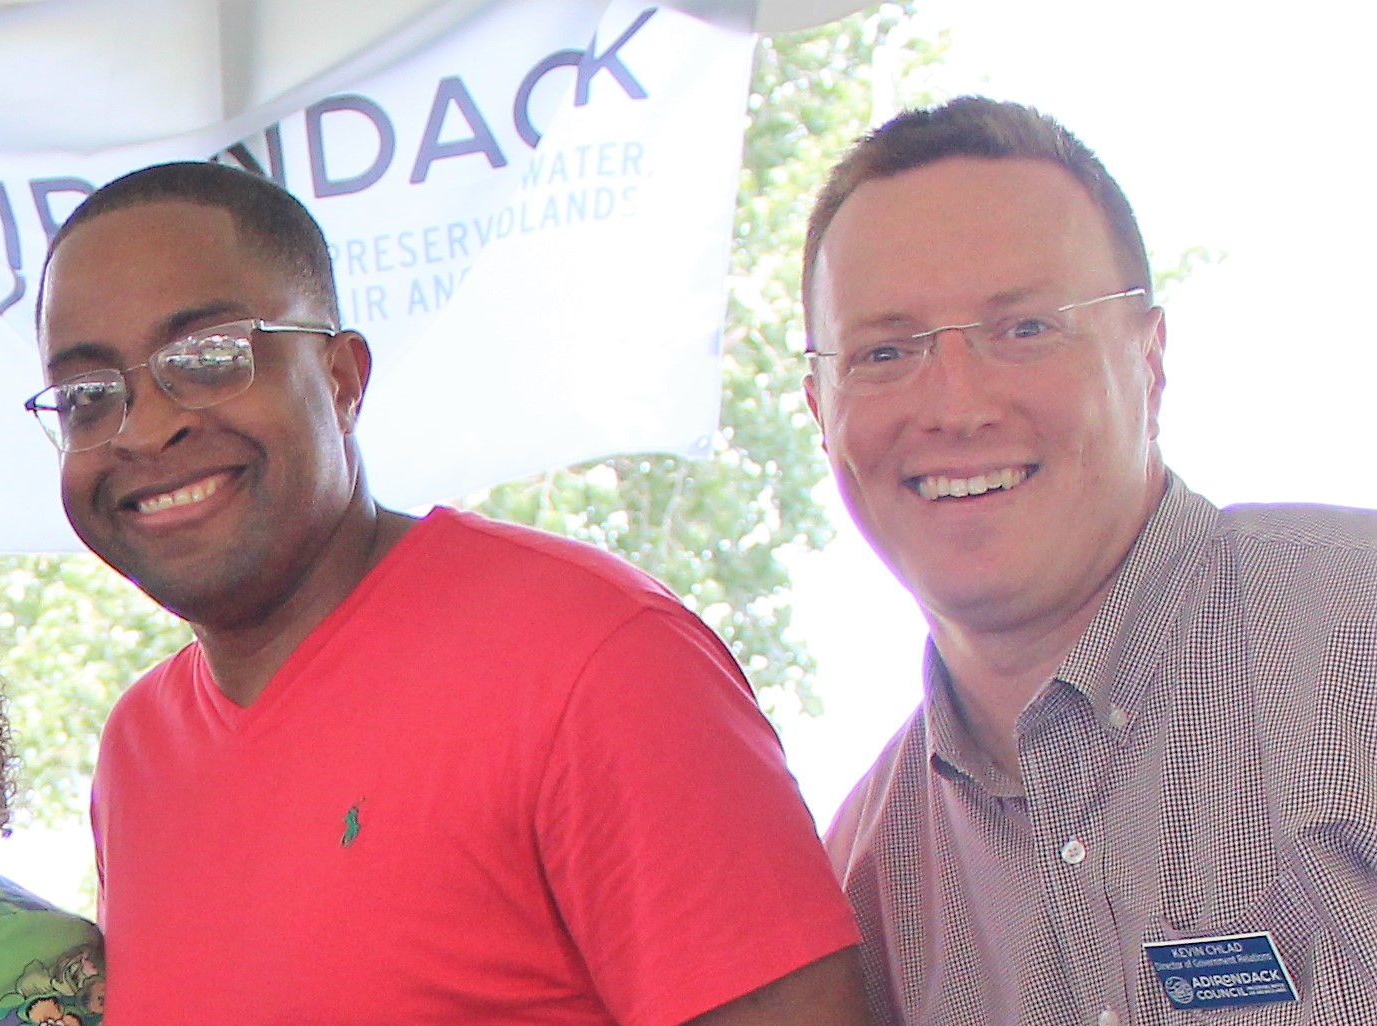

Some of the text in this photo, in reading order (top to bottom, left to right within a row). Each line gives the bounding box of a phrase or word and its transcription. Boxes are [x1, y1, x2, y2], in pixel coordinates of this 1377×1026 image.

[407, 266, 471, 315] AN
[1171, 942, 1242, 958] KEVIN CHLAD
[1192, 970, 1281, 988] ADIRONDACK
[1197, 988, 1248, 1000] COUNCIL
